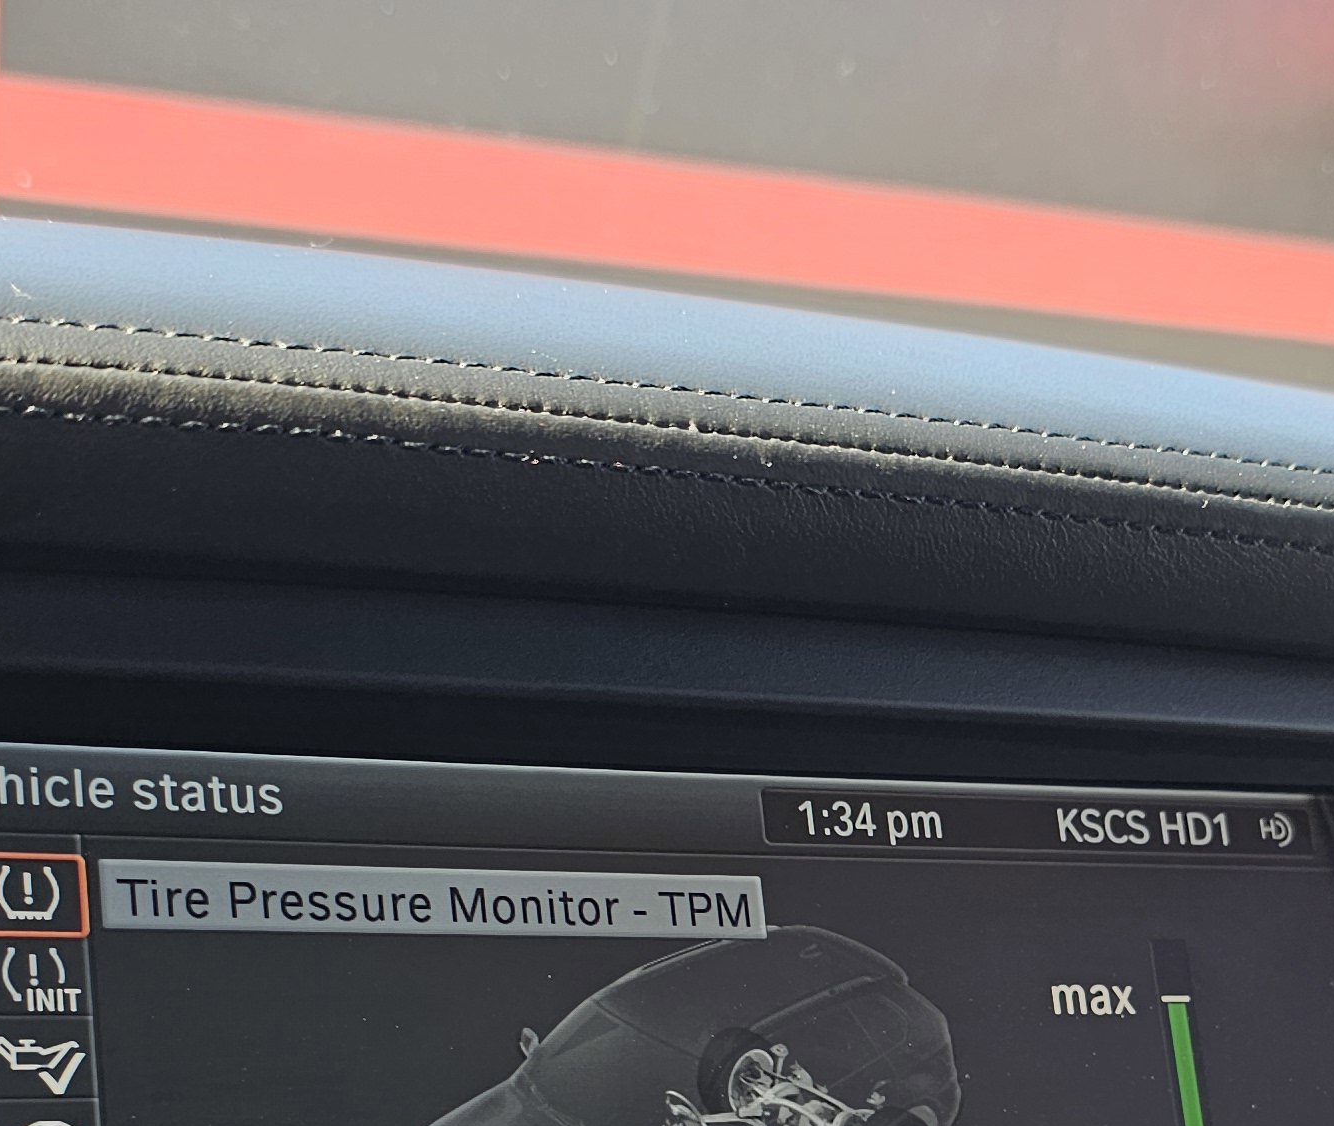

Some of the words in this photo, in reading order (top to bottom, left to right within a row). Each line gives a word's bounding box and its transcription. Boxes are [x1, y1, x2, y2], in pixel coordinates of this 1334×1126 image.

[133, 772, 284, 815] status
[797, 800, 878, 838] 1:34
[887, 804, 943, 845] pm
[1057, 807, 1150, 845] KSCS
[1159, 810, 1230, 848] HD1
[116, 877, 209, 919] Tire
[228, 881, 432, 923] Pressure
[450, 885, 619, 927] Monitor
[657, 891, 753, 928] TPM
[26, 988, 82, 1012] INIT
[1051, 983, 1137, 1016] max
